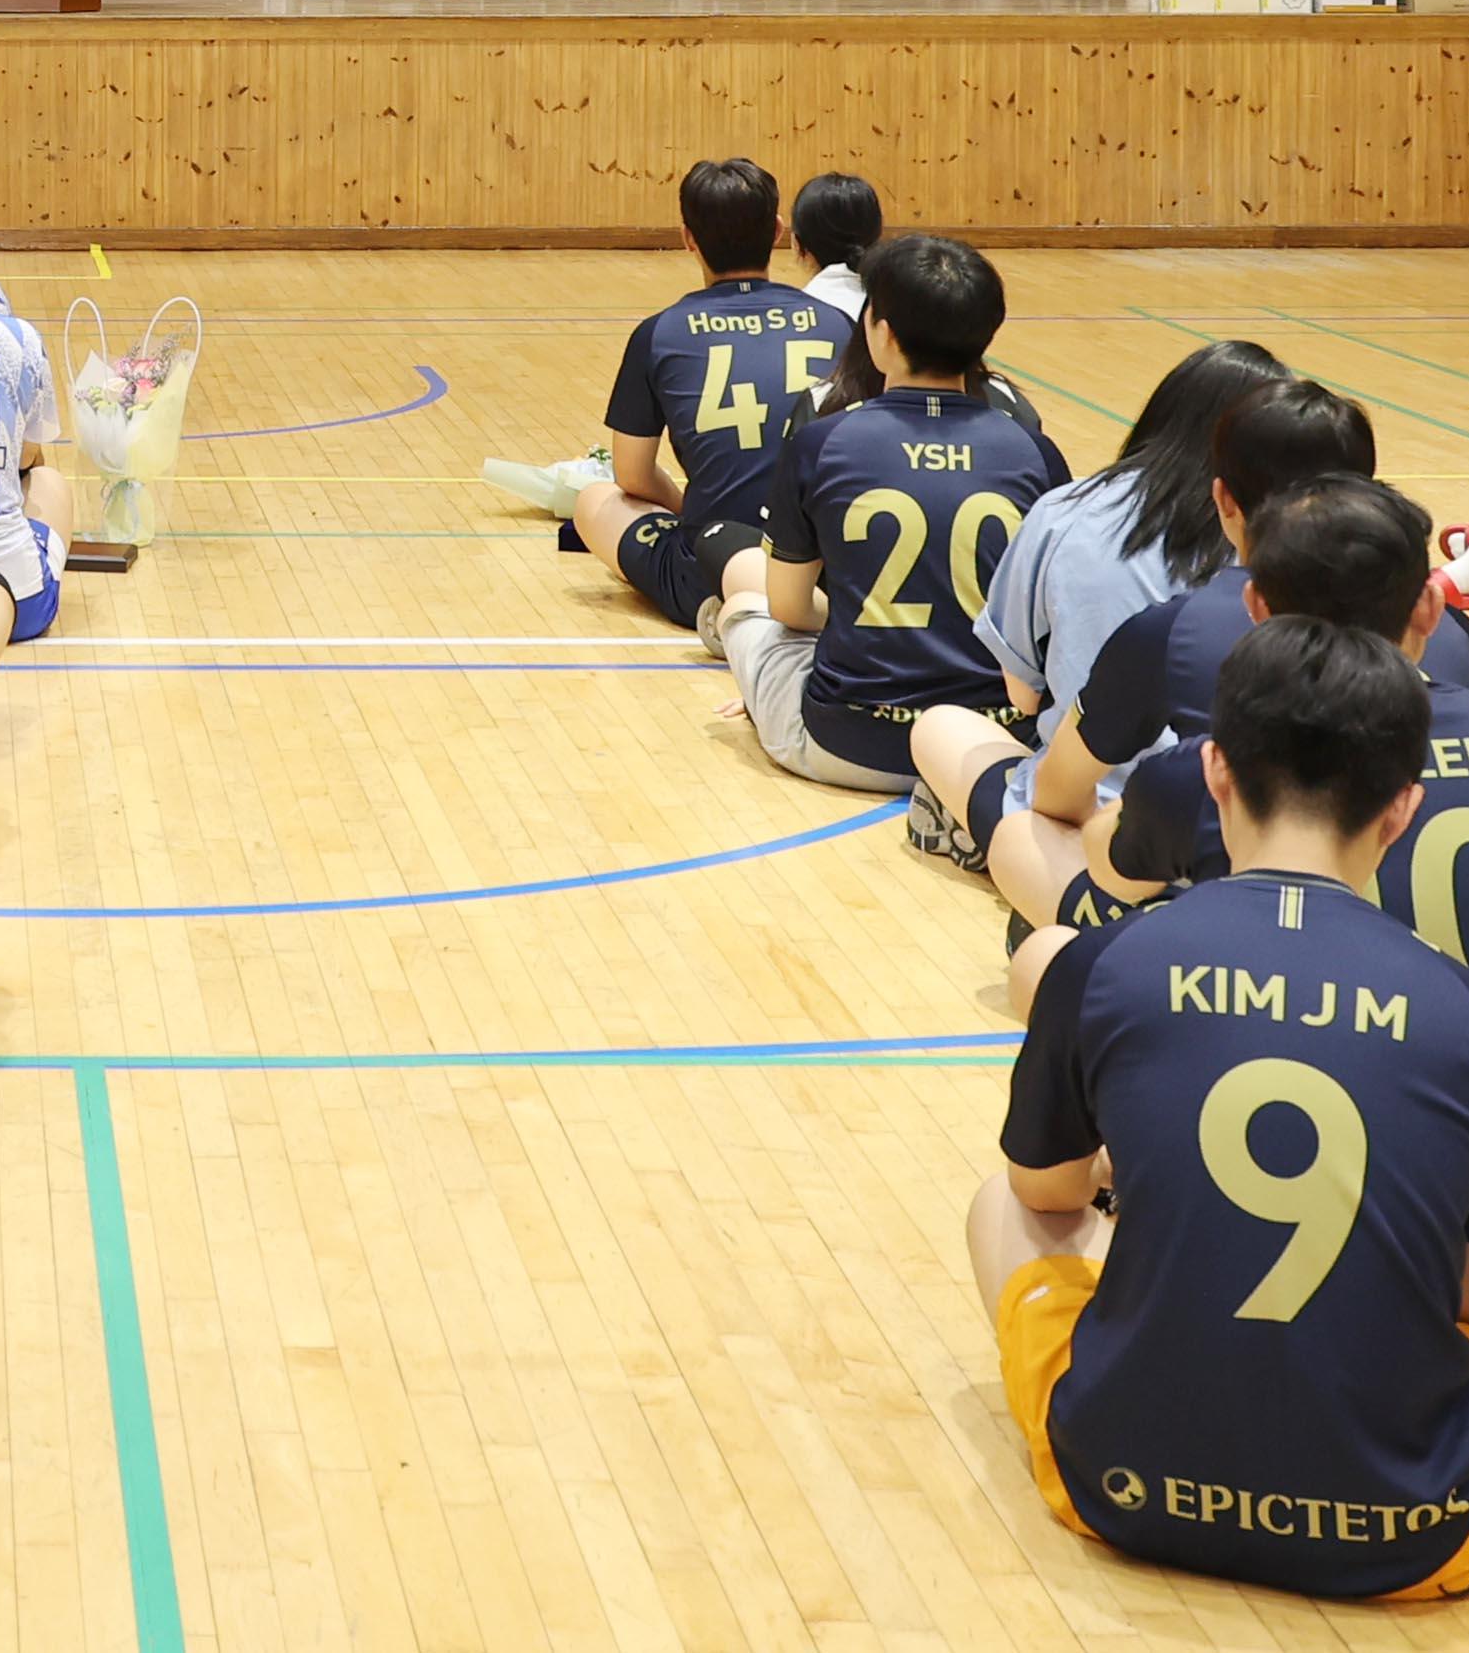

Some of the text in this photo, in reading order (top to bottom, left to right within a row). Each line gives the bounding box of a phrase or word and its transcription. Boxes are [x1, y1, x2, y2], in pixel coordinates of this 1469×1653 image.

[687, 305, 818, 336] Hong S gi
[901, 442, 972, 472] YSH
[1169, 965, 1410, 1042] KIM J M
[1198, 1057, 1369, 1323] 9
